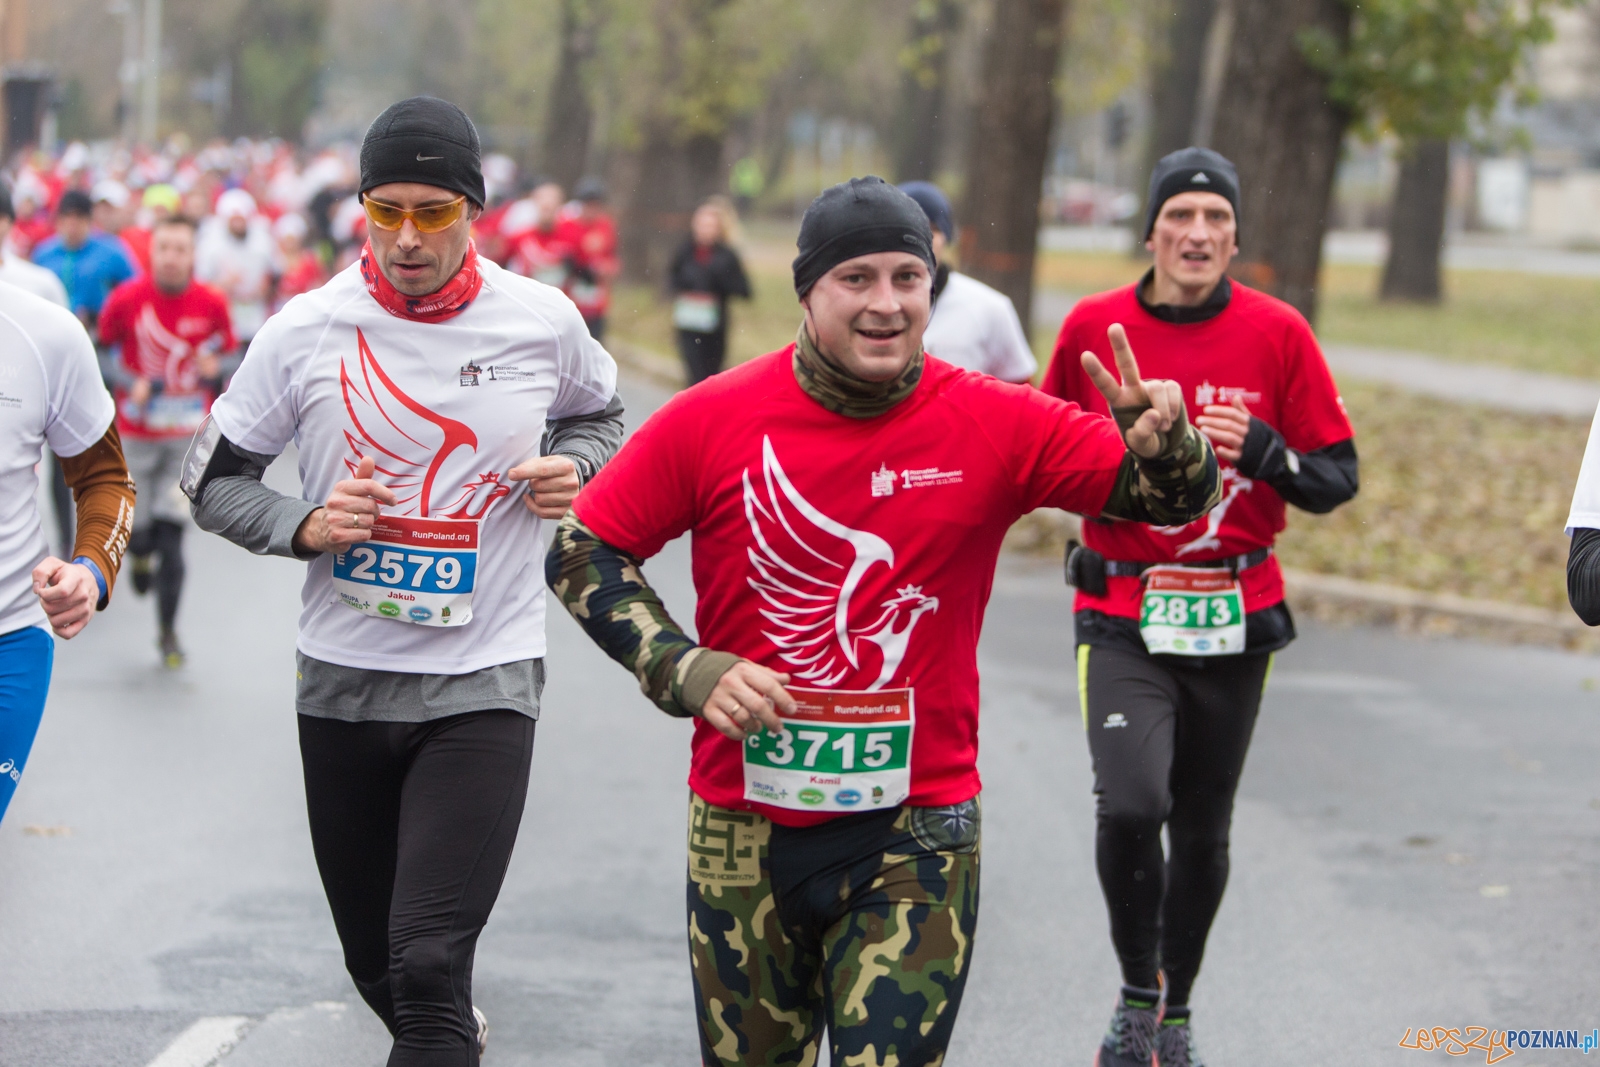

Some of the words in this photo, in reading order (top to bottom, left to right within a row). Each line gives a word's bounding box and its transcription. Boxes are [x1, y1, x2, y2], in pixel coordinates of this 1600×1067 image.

[487, 366, 497, 380] 1
[901, 469, 912, 488] 1
[412, 531, 470, 542] RunPoland.org
[336, 554, 345, 565] E
[350, 547, 462, 590] 2579
[387, 591, 416, 602] Jakub
[1146, 596, 1232, 626] 2813
[834, 704, 901, 714] RunPoland.org
[765, 728, 893, 769] 3715
[810, 775, 841, 785] Kamil
